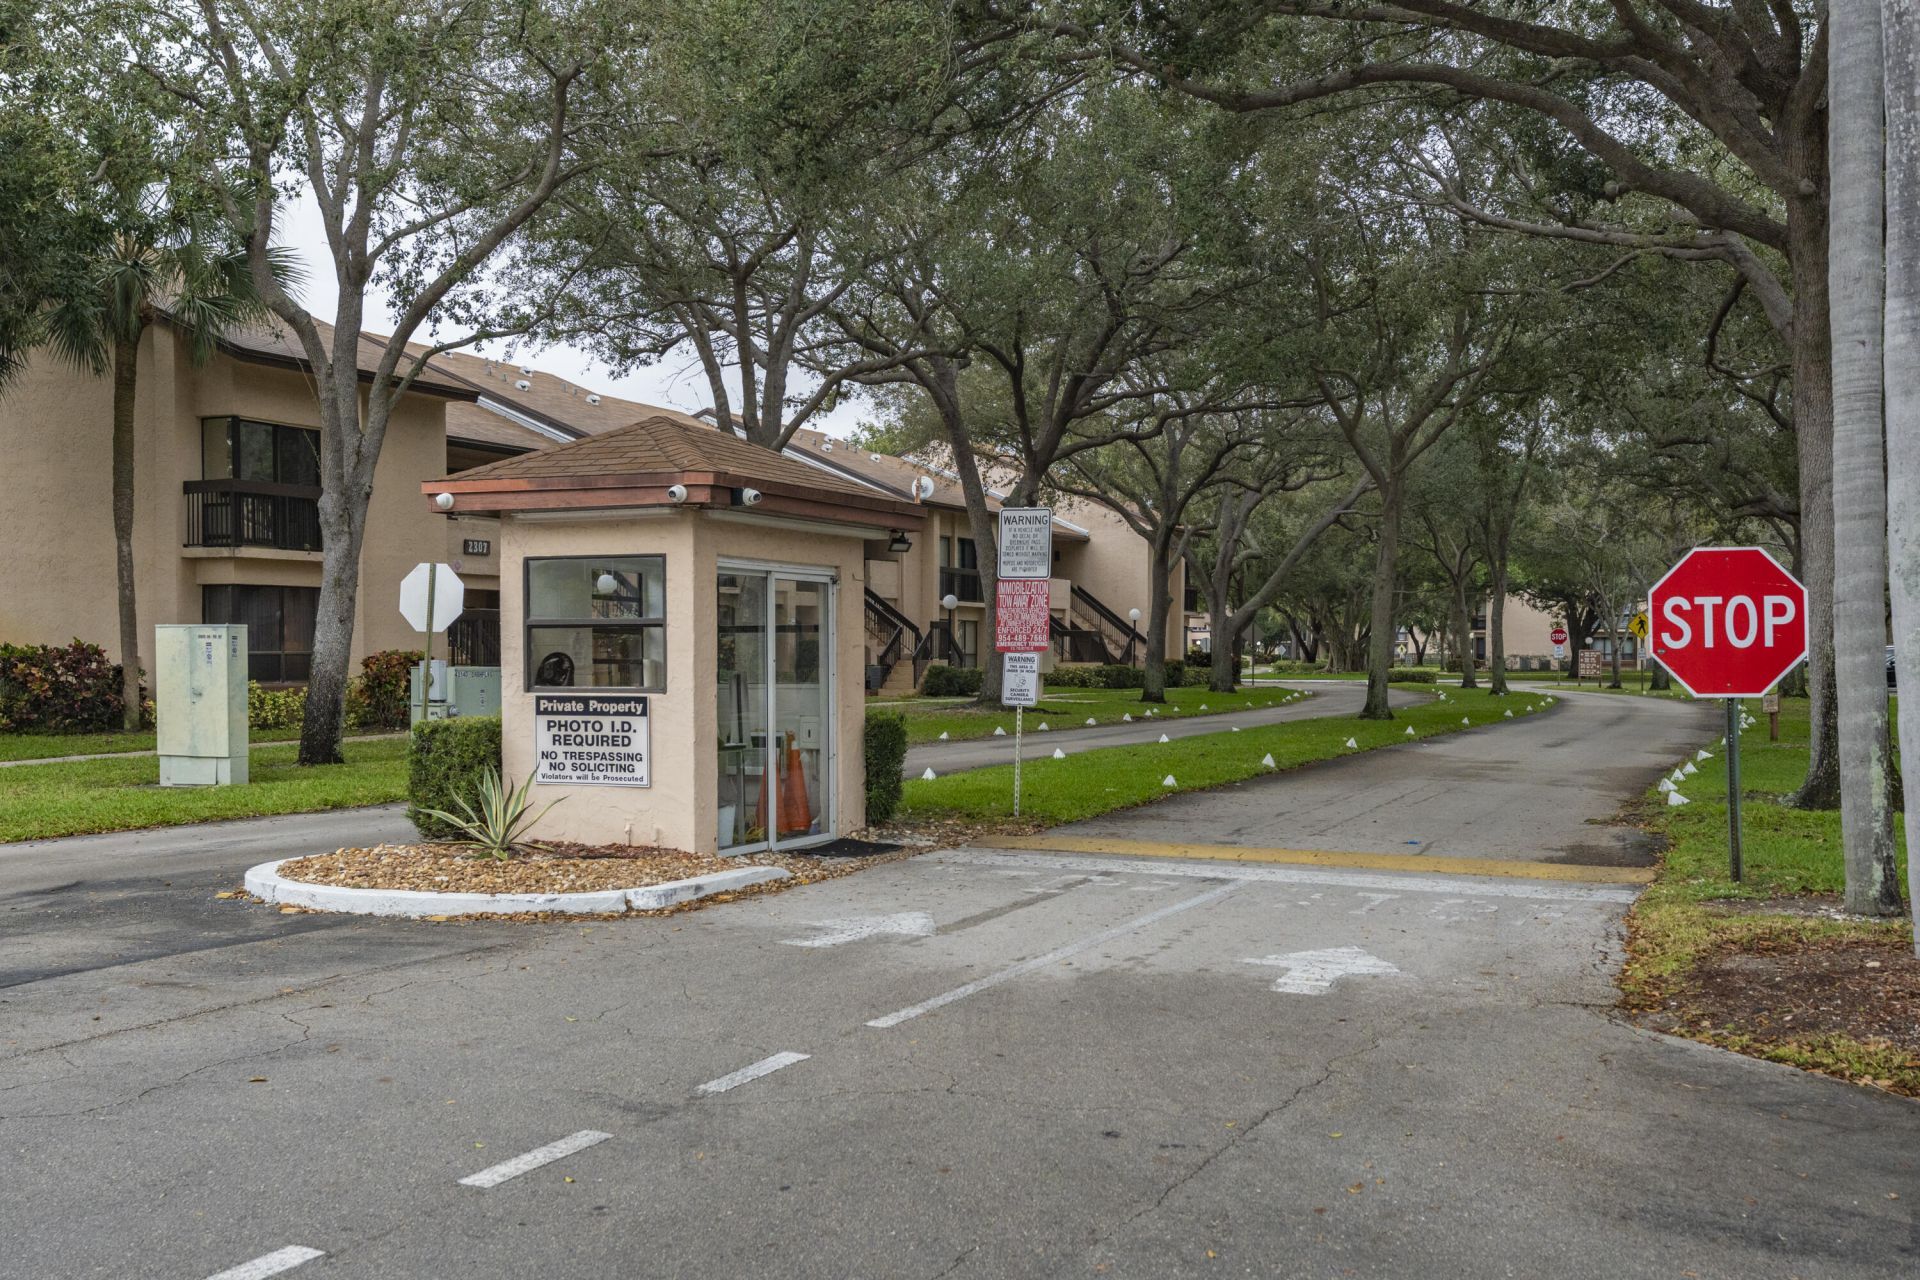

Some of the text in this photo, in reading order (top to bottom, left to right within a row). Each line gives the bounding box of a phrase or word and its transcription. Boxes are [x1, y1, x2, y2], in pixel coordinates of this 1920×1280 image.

[1003, 515, 1048, 525] WARNING
[468, 541, 487, 553] 2307
[999, 582, 1048, 594] IMMOBILIZATION
[999, 595, 1048, 608] TOW AWAY ZONE
[1661, 595, 1796, 649] STOP
[540, 700, 643, 715] Private Property
[547, 720, 637, 733] PHOTO I.D.
[552, 734, 631, 747] REQUIRED
[541, 751, 643, 762] NO TRESPASSING
[549, 762, 635, 773] NO SOLICITING
[591, 773, 600, 781] be
